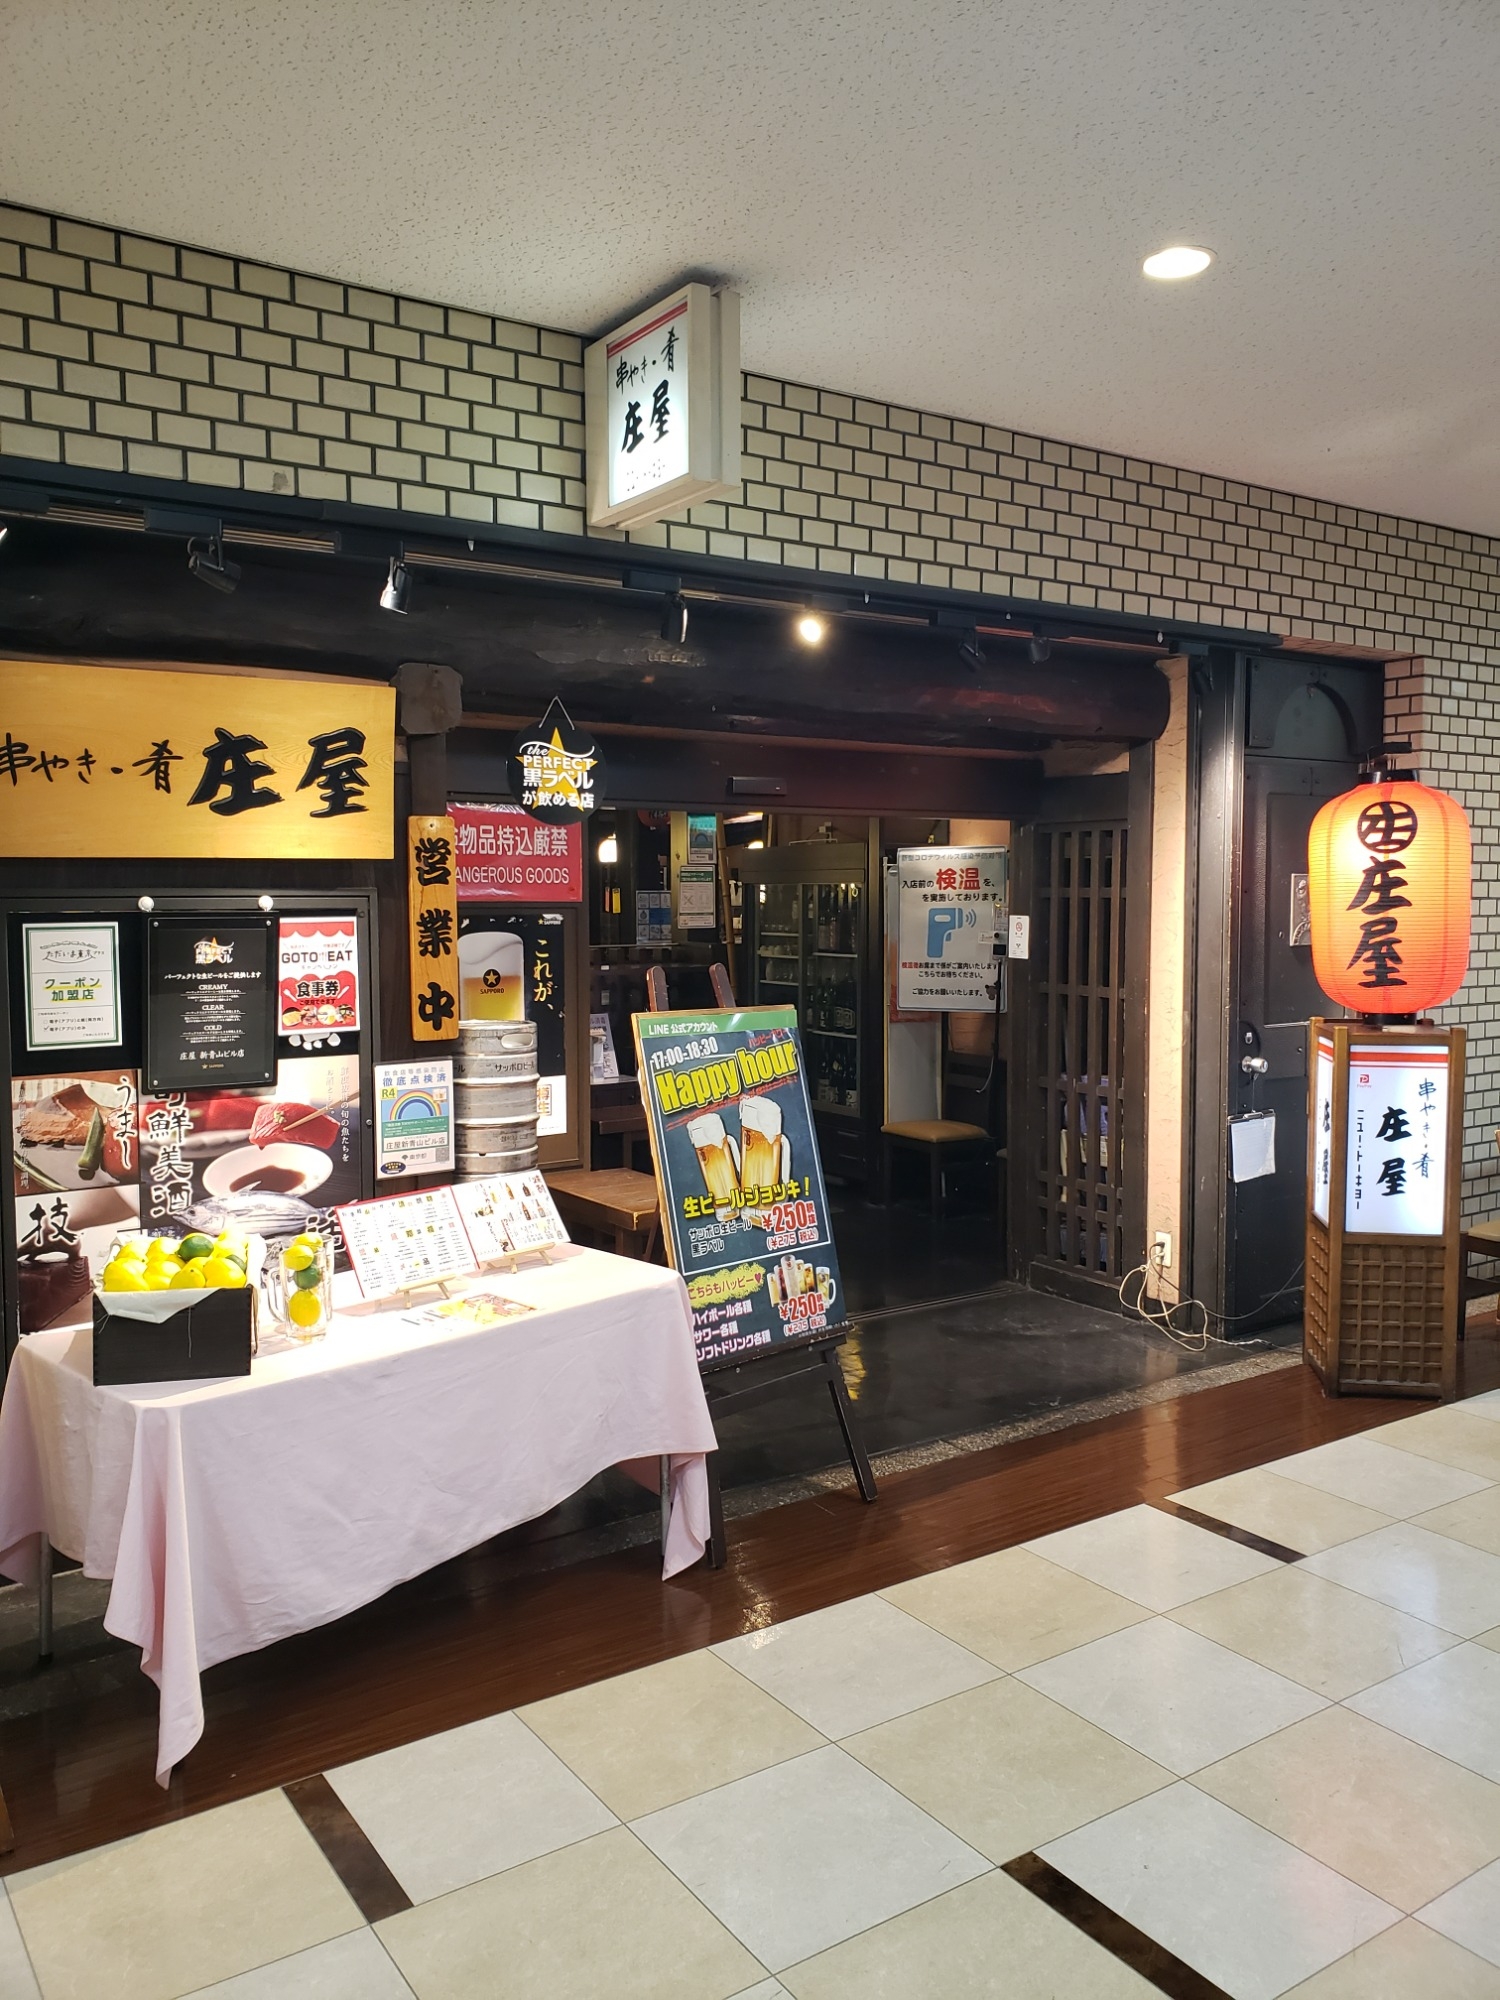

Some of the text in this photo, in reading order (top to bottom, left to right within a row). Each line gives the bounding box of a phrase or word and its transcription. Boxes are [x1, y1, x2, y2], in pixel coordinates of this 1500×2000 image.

[615, 326, 680, 395] 串やき・肴
[621, 379, 671, 454] 庄屋
[526, 744, 550, 757] the
[187, 726, 371, 818] 庄屋
[523, 755, 594, 771] PERFECT
[523, 768, 594, 789] 黒ラベル
[522, 790, 595, 809] が飲める店
[456, 866, 570, 884] ANGEROUS GOODS
[1345, 855, 1413, 988] 庄屋
[414, 836, 456, 1032] 営業中
[327, 950, 353, 962] EAT
[44, 977, 101, 990] クーポン
[533, 938, 554, 1010] これが、
[51, 989, 94, 1002] 加盟店
[198, 983, 228, 991] CREAMY
[297, 980, 339, 998] 食事券
[480, 987, 505, 995] SAPPORO
[203, 1024, 223, 1032] COLD
[648, 1023, 718, 1036] LINE 公式アカウント
[651, 1036, 719, 1070] 17:00-18:30
[495, 1060, 535, 1073] サッポロビール
[654, 1055, 741, 1113] Happy
[738, 1040, 798, 1086] hour
[381, 1088, 396, 1099] R4
[386, 1136, 446, 1151] 庄屋新青山ビル店
[1375, 1105, 1413, 1197] 庄屋
[20, 1196, 78, 1245] 技
[762, 1201, 809, 1234] ¥250
[689, 1218, 753, 1242] サッポロ生ビール
[691, 1237, 725, 1258] 黒ラベル
[693, 1299, 754, 1327] ハイボール各種
[693, 1320, 739, 1344] サワー各種
[696, 1328, 772, 1362] ソフトドリンク各種
